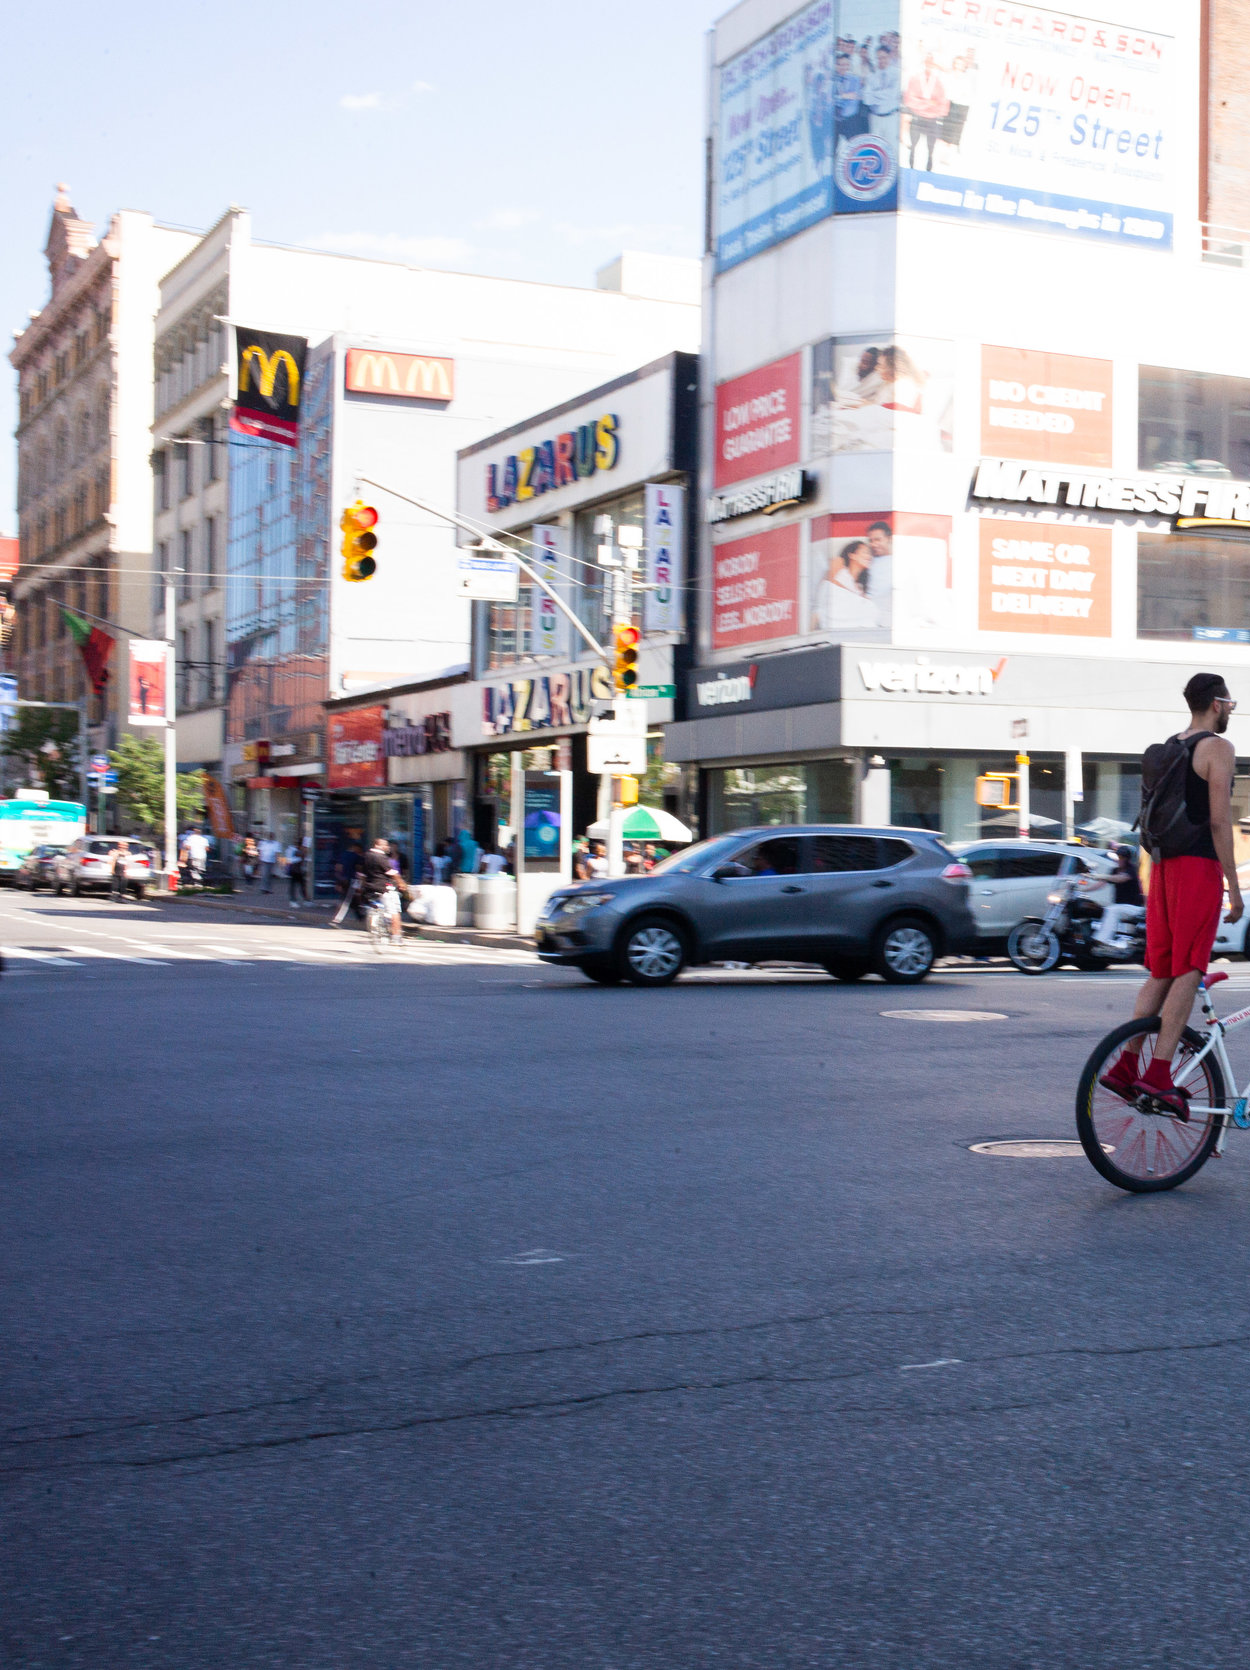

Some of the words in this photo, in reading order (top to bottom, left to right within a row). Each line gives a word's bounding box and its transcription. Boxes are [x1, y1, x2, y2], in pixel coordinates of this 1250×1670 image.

[964, 0, 1087, 44] RICHARD
[1091, 29, 1107, 49] &
[1115, 33, 1163, 60] SON
[1000, 61, 1060, 97] Now
[1069, 113, 1164, 160] Street
[989, 379, 1026, 403] NO
[1027, 383, 1106, 412] CREDIT
[723, 402, 751, 431] LOW
[989, 406, 1075, 434] NEEDED
[722, 417, 792, 461] GUARANTEE
[486, 411, 620, 514] LAZARUS
[655, 489, 672, 624] LAZARUS
[992, 538, 1054, 563] SAME
[1055, 543, 1090, 566] OR
[992, 565, 1048, 589] NEXT
[992, 592, 1094, 618] DELIVERY
[858, 655, 994, 697] verizon
[481, 665, 613, 736] LAZARUS
